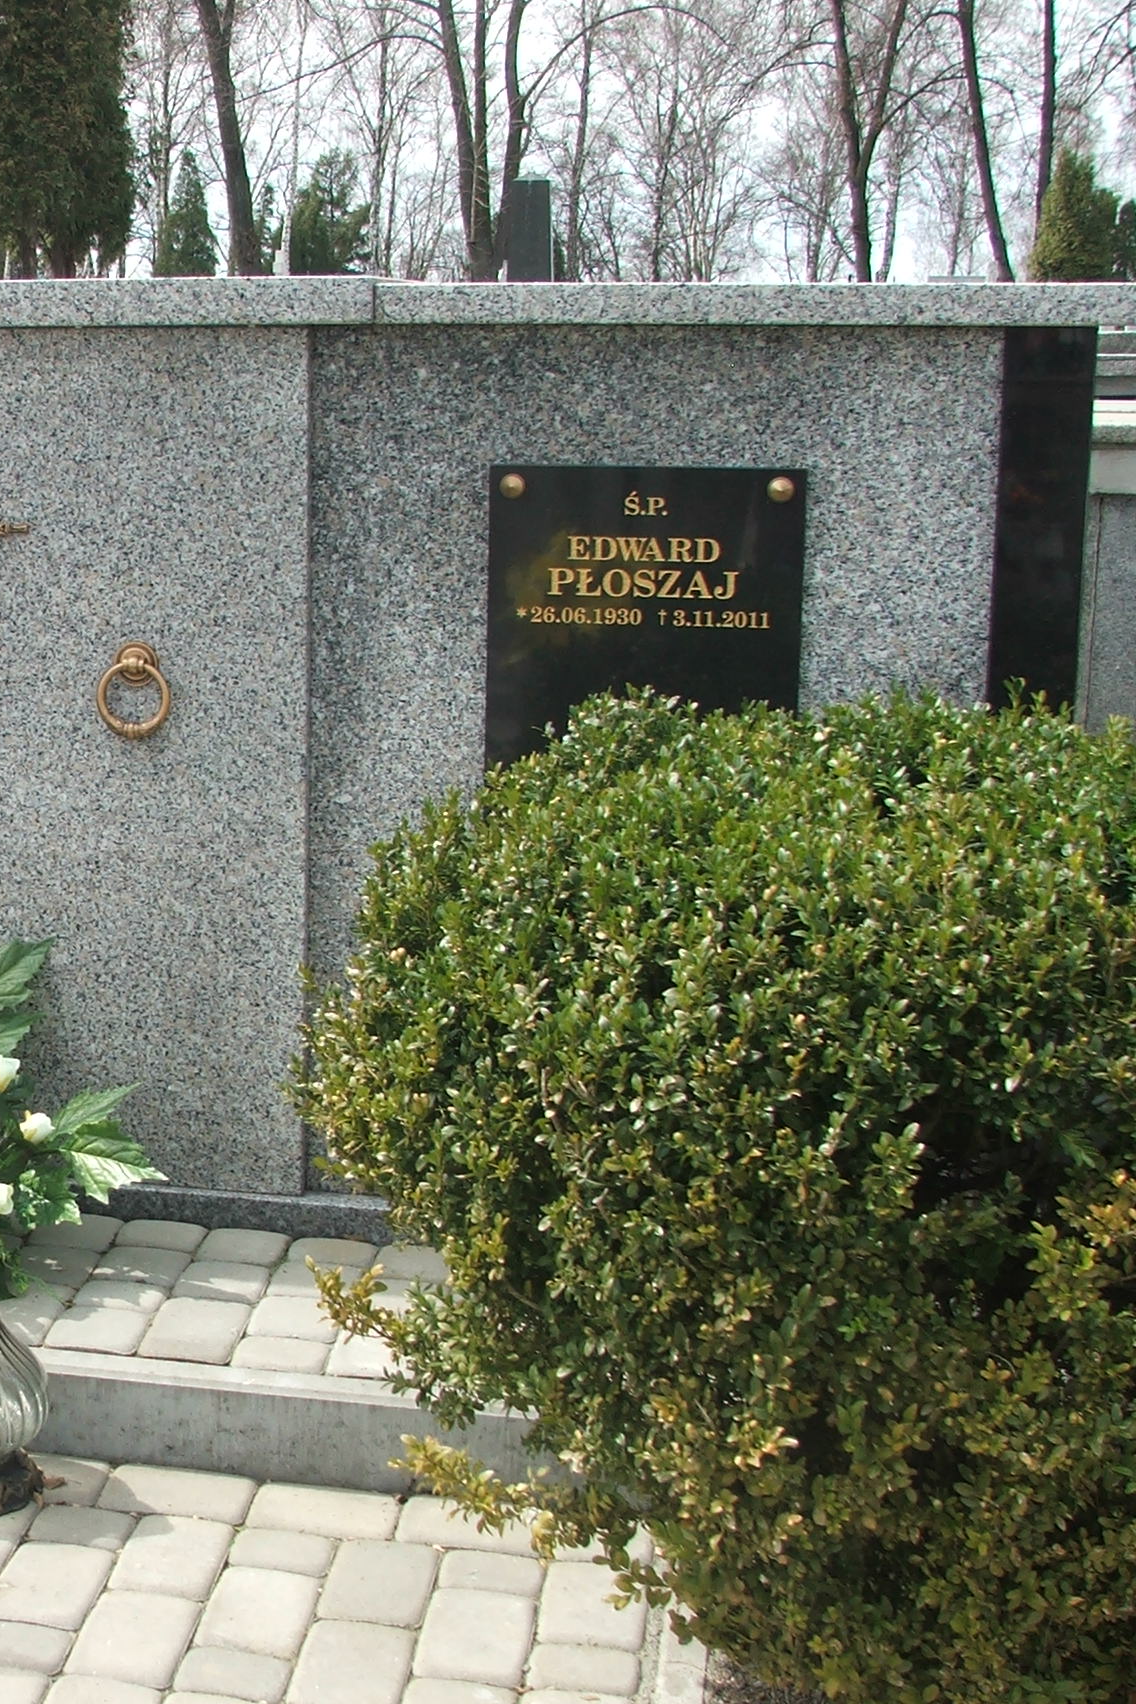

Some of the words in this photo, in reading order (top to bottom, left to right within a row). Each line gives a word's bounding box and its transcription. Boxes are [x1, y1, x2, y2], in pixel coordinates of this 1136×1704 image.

[624, 490, 668, 516] Ś.P.
[567, 535, 721, 563] EDWARD
[546, 567, 740, 600] PŁOSZAJ
